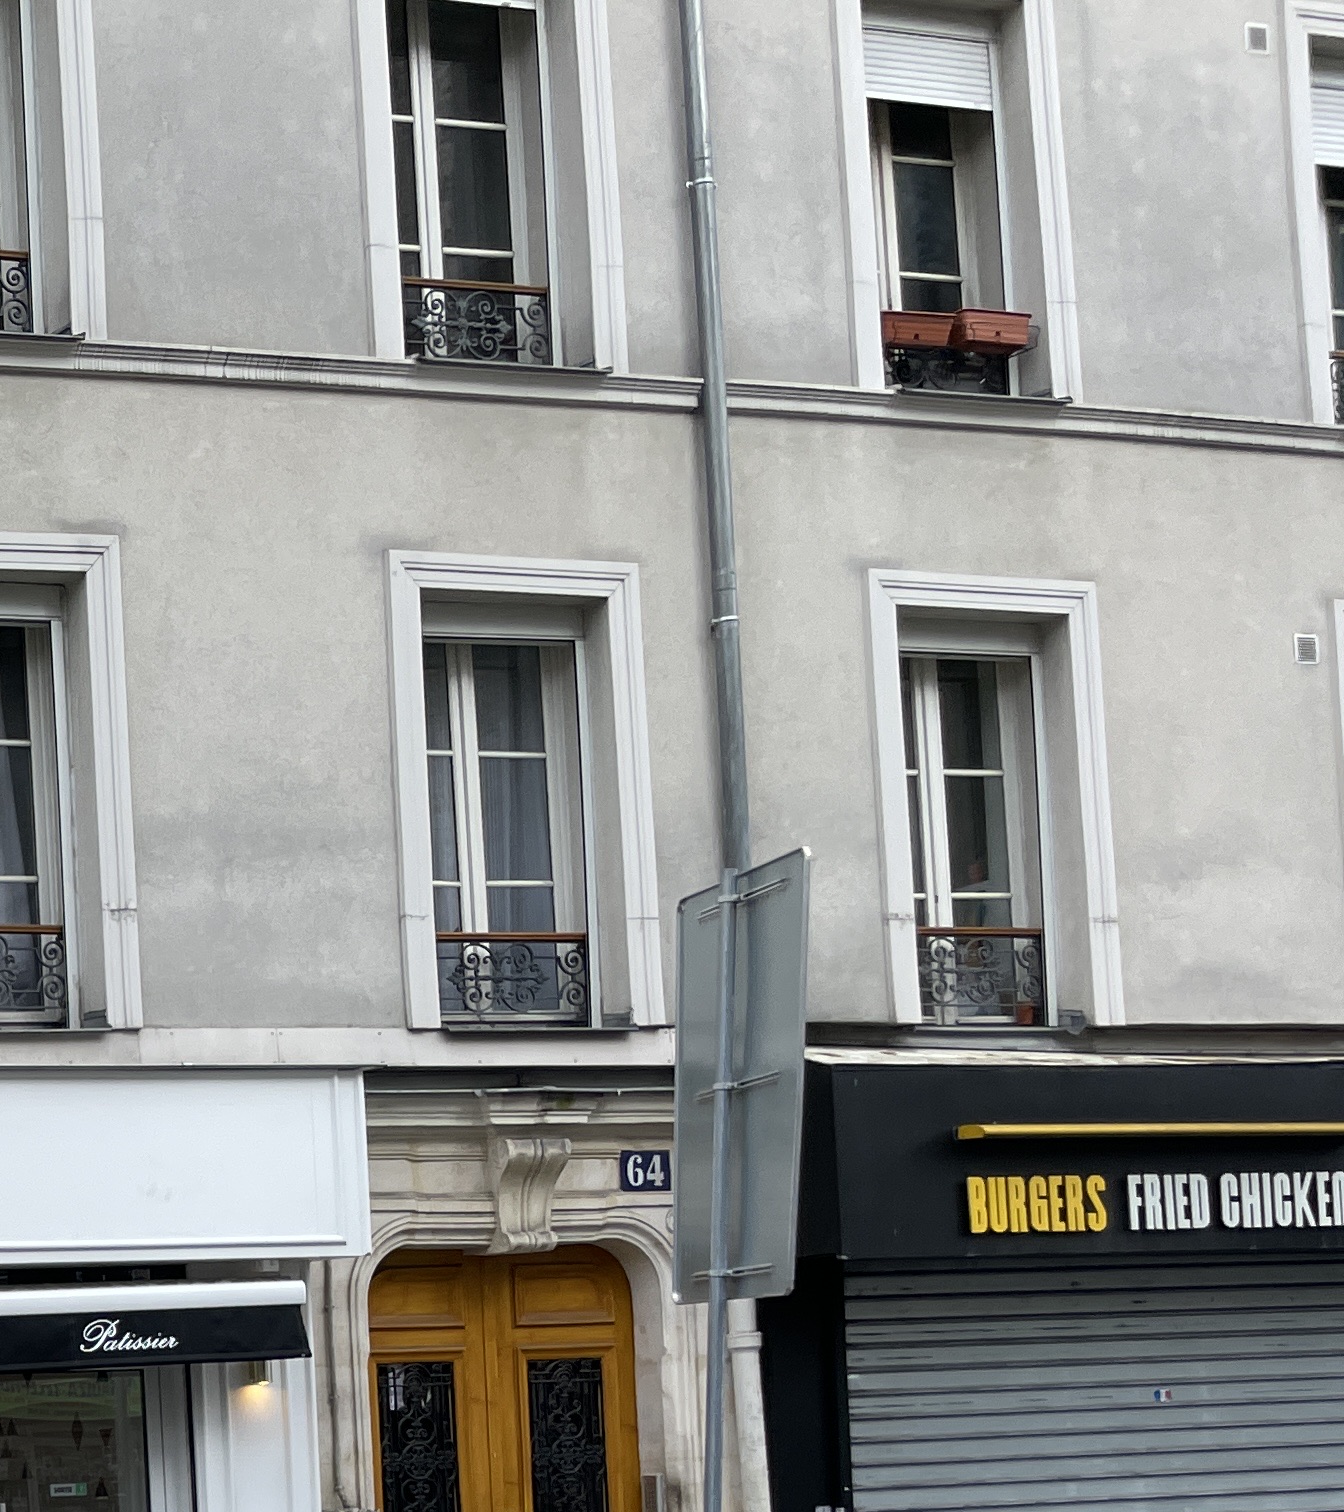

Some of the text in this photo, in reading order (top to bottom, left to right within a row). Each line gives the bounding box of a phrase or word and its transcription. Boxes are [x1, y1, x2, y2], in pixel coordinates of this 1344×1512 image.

[626, 1154, 665, 1187] 64
[966, 1174, 1108, 1234] BURGERS
[1126, 1172, 1211, 1231] FRIED
[79, 1319, 180, 1353] Patissier
